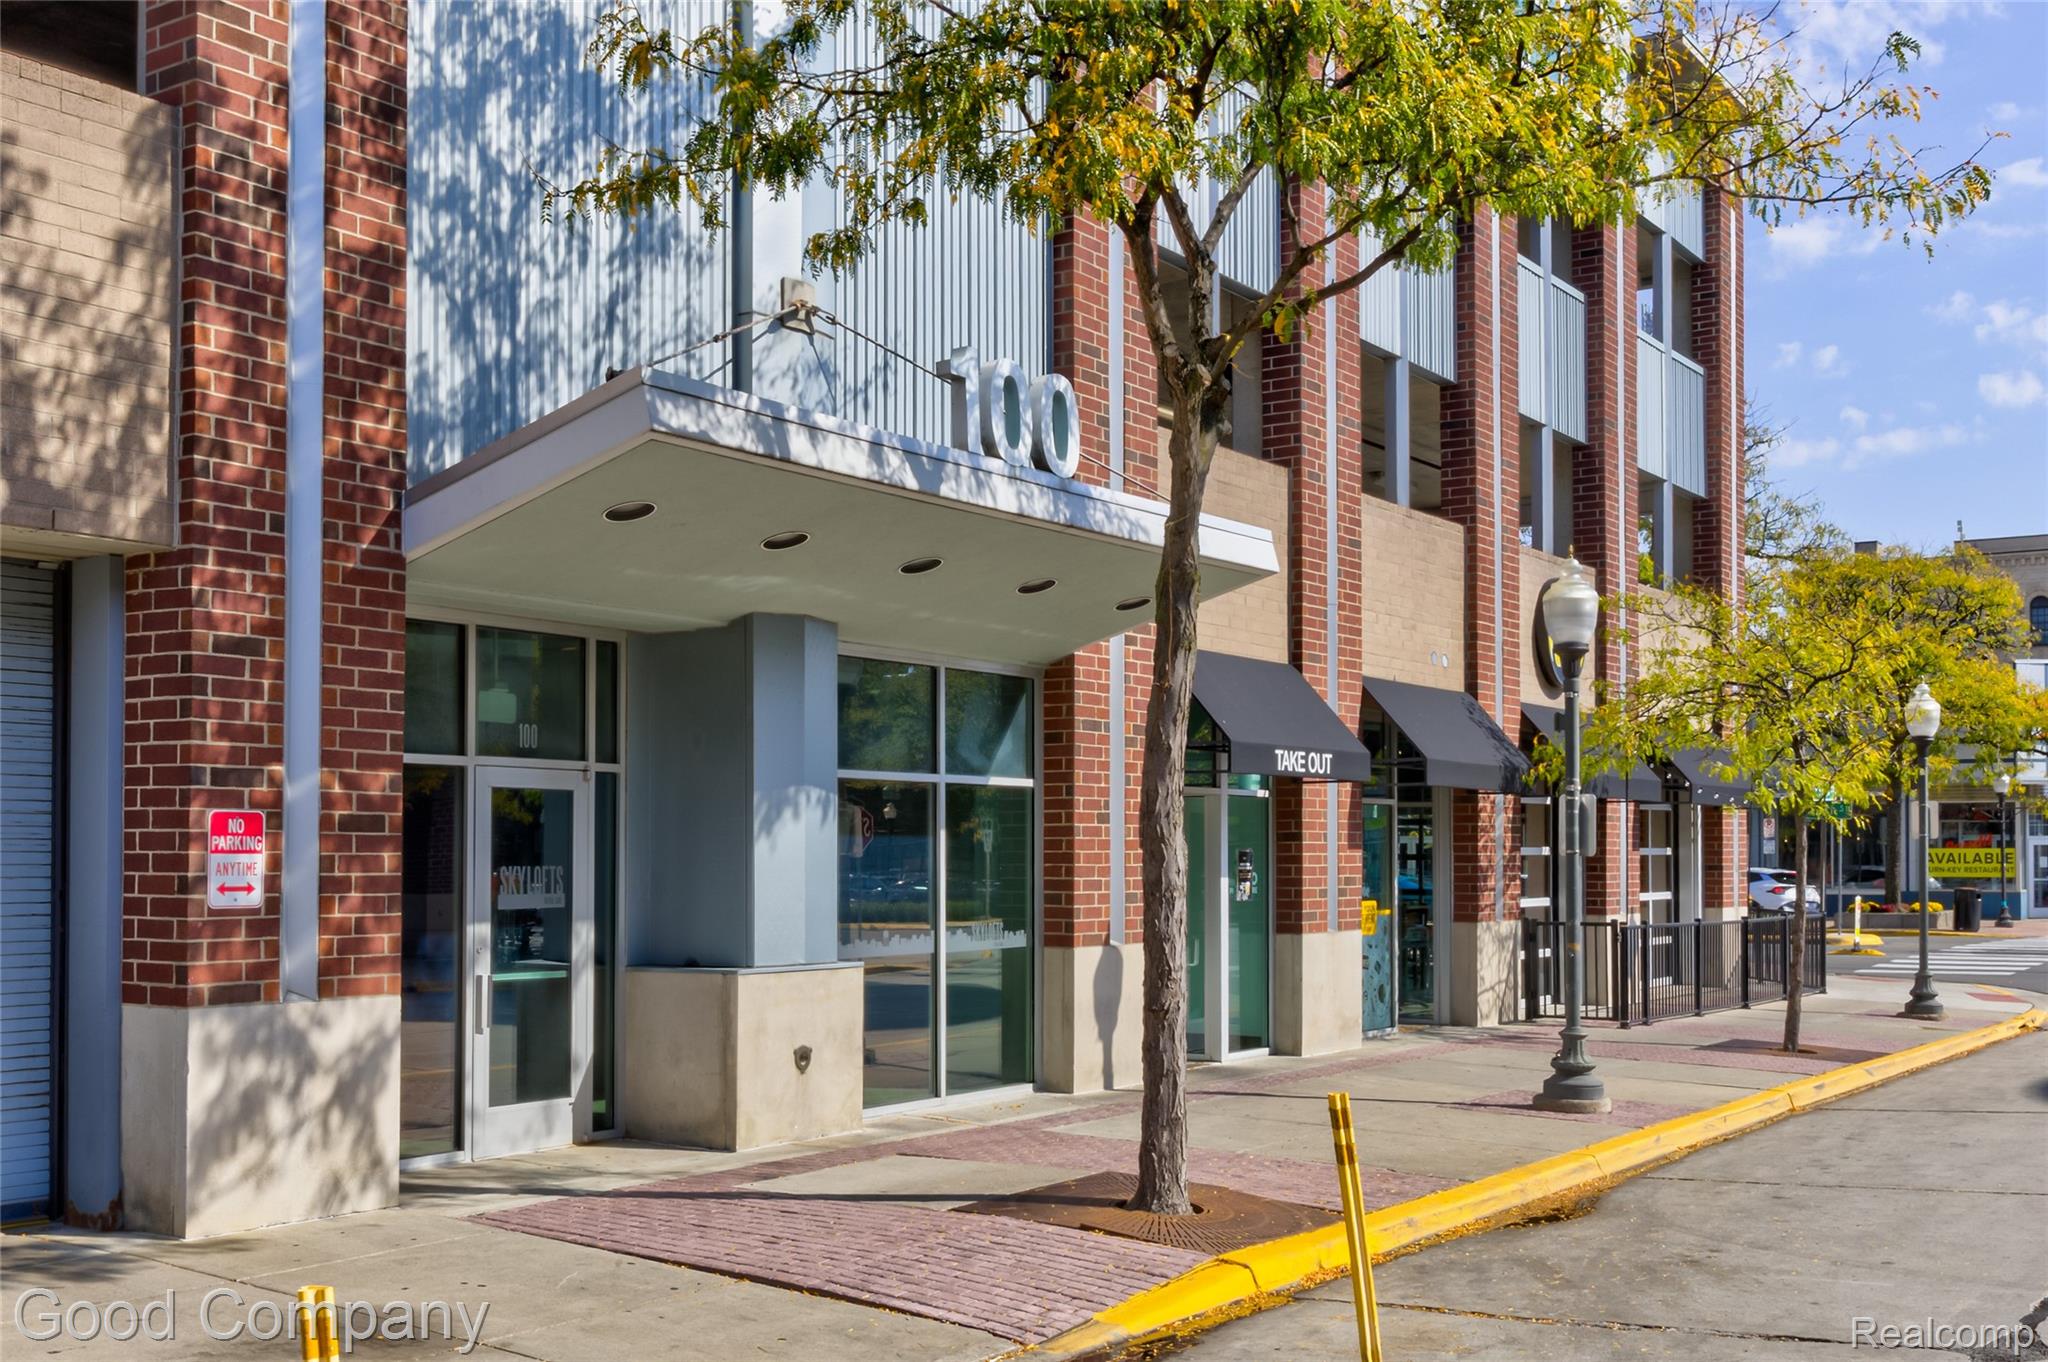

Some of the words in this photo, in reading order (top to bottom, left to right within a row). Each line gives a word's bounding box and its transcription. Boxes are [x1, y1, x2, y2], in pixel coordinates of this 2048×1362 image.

[936, 346, 1080, 478] 100
[519, 723, 538, 749] 100
[1274, 749, 1306, 772] TAKE
[1308, 752, 1333, 774] OUT
[228, 818, 245, 833] NO
[211, 835, 263, 851] PARKING
[1928, 852, 2014, 864] AVAILABLE
[215, 861, 258, 877] ANYTIME
